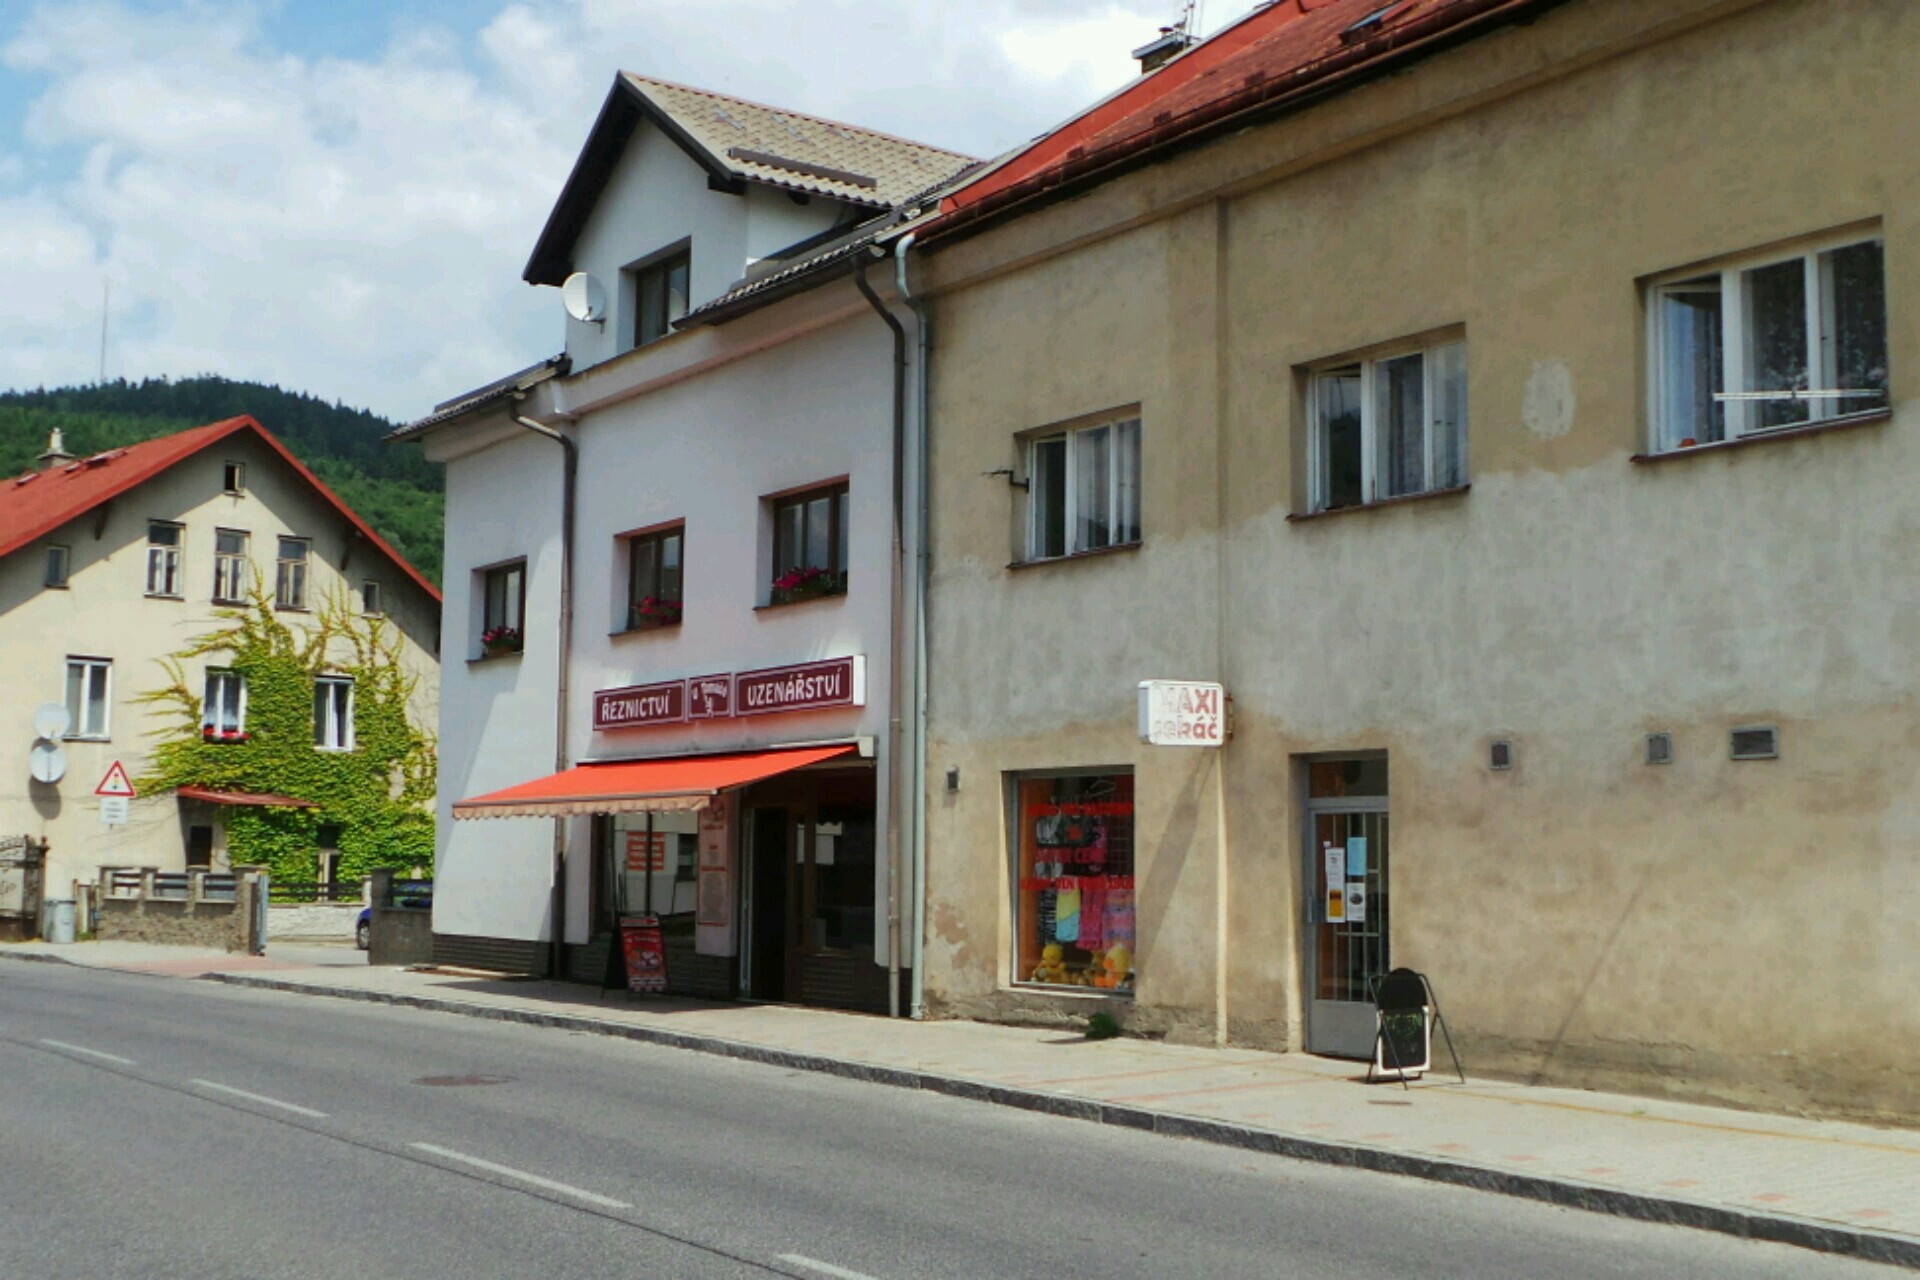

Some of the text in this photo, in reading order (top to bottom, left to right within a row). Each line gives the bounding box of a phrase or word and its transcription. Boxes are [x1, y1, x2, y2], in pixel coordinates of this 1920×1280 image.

[748, 667, 842, 707] UZENÁŘSTVÍ
[1154, 687, 1218, 714] AXI
[602, 690, 670, 722] ŘEZNICTVÍ
